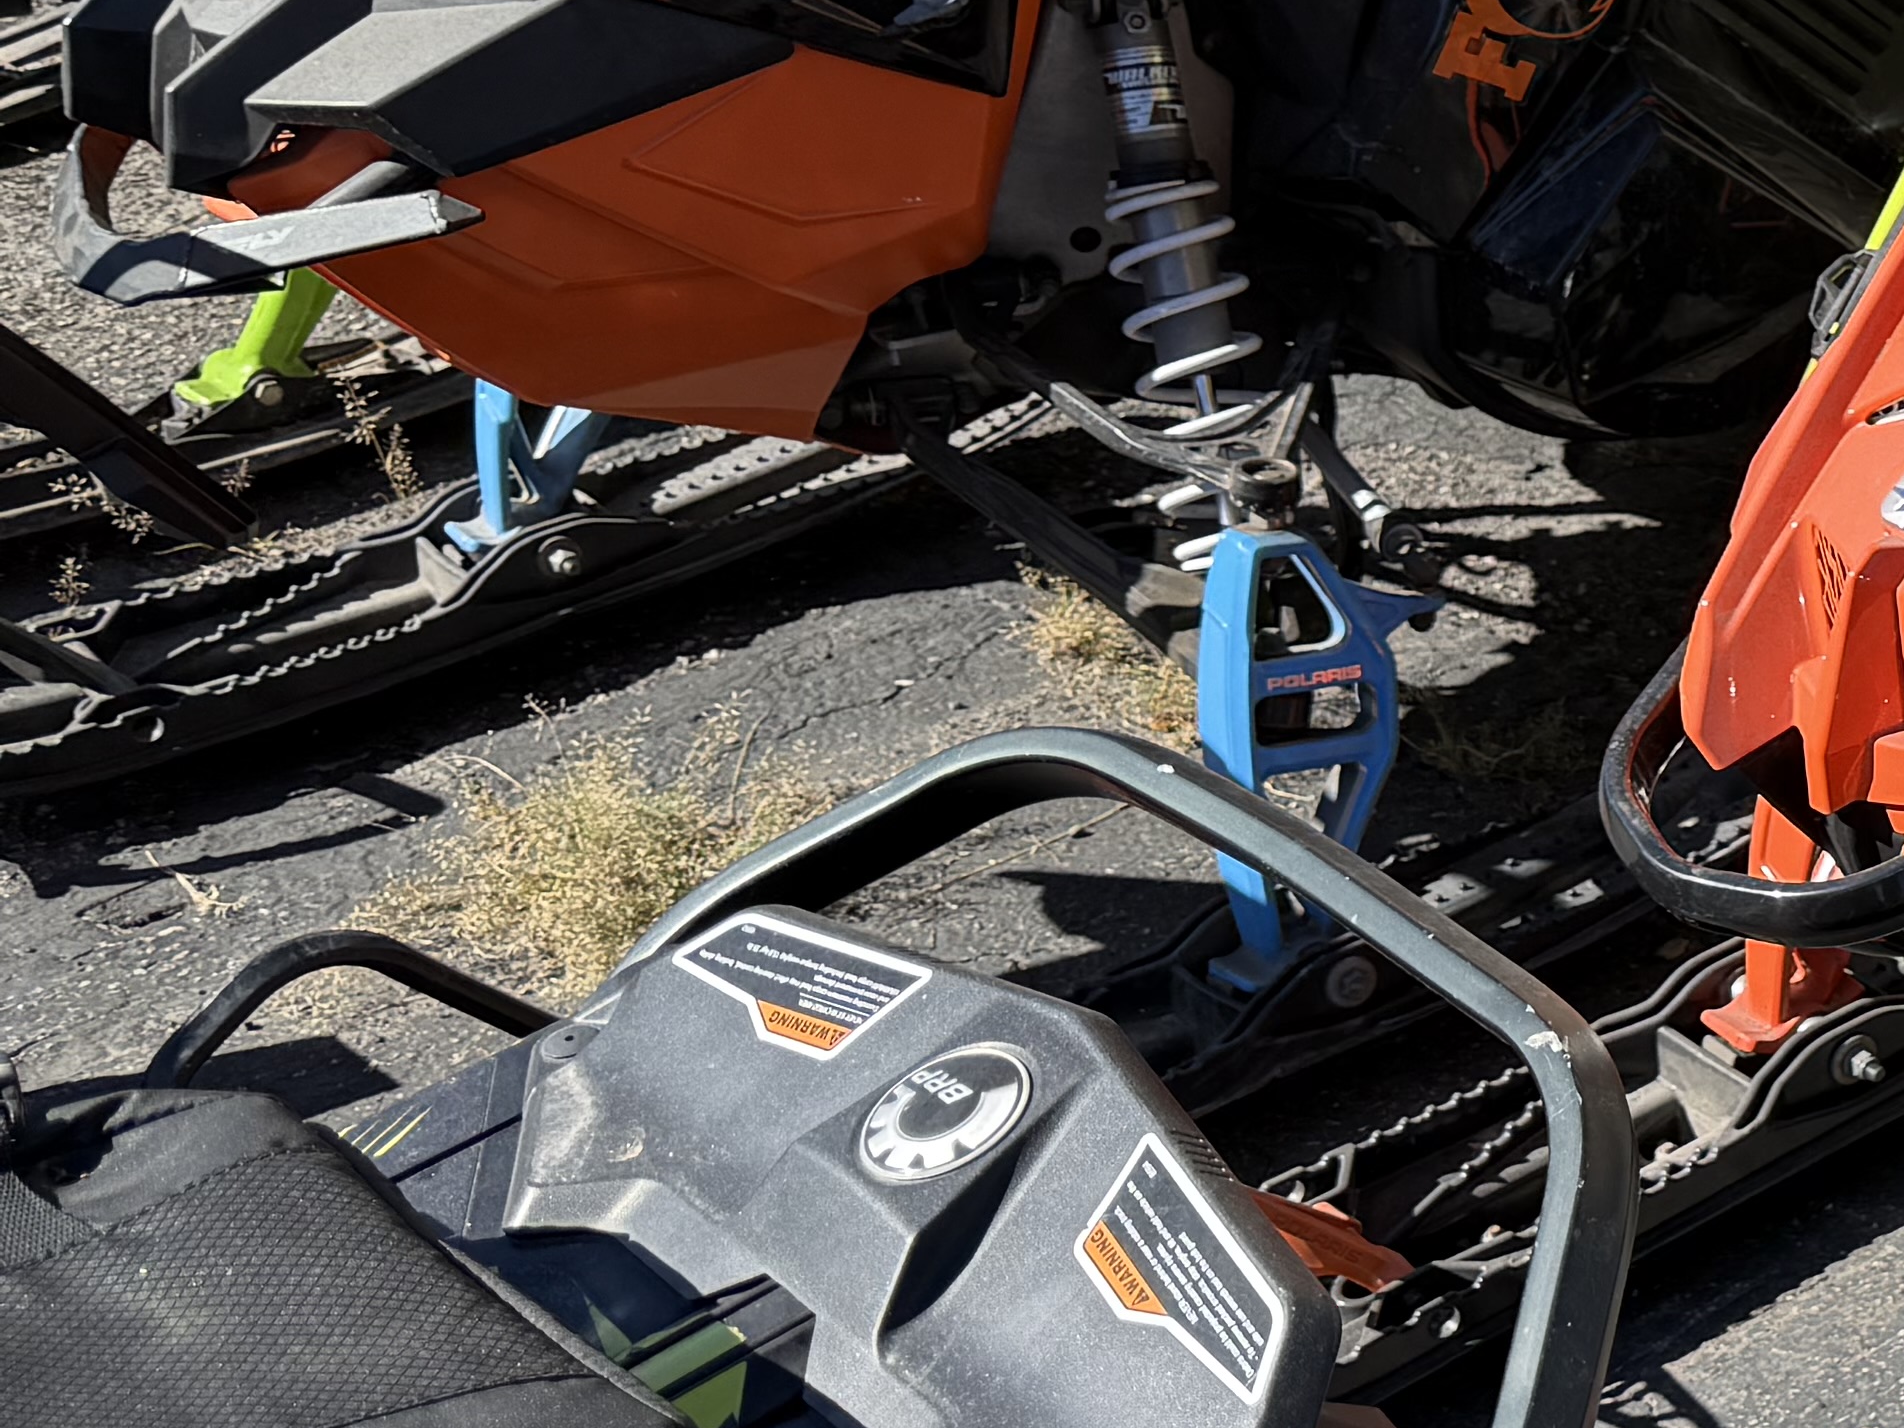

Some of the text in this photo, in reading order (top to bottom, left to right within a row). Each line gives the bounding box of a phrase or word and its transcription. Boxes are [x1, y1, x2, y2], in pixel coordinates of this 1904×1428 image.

[1266, 663, 1363, 692] POLARIS
[767, 1007, 831, 1041] WARNING
[908, 1068, 974, 1105] BRP
[1086, 1227, 1144, 1296] WARNING
